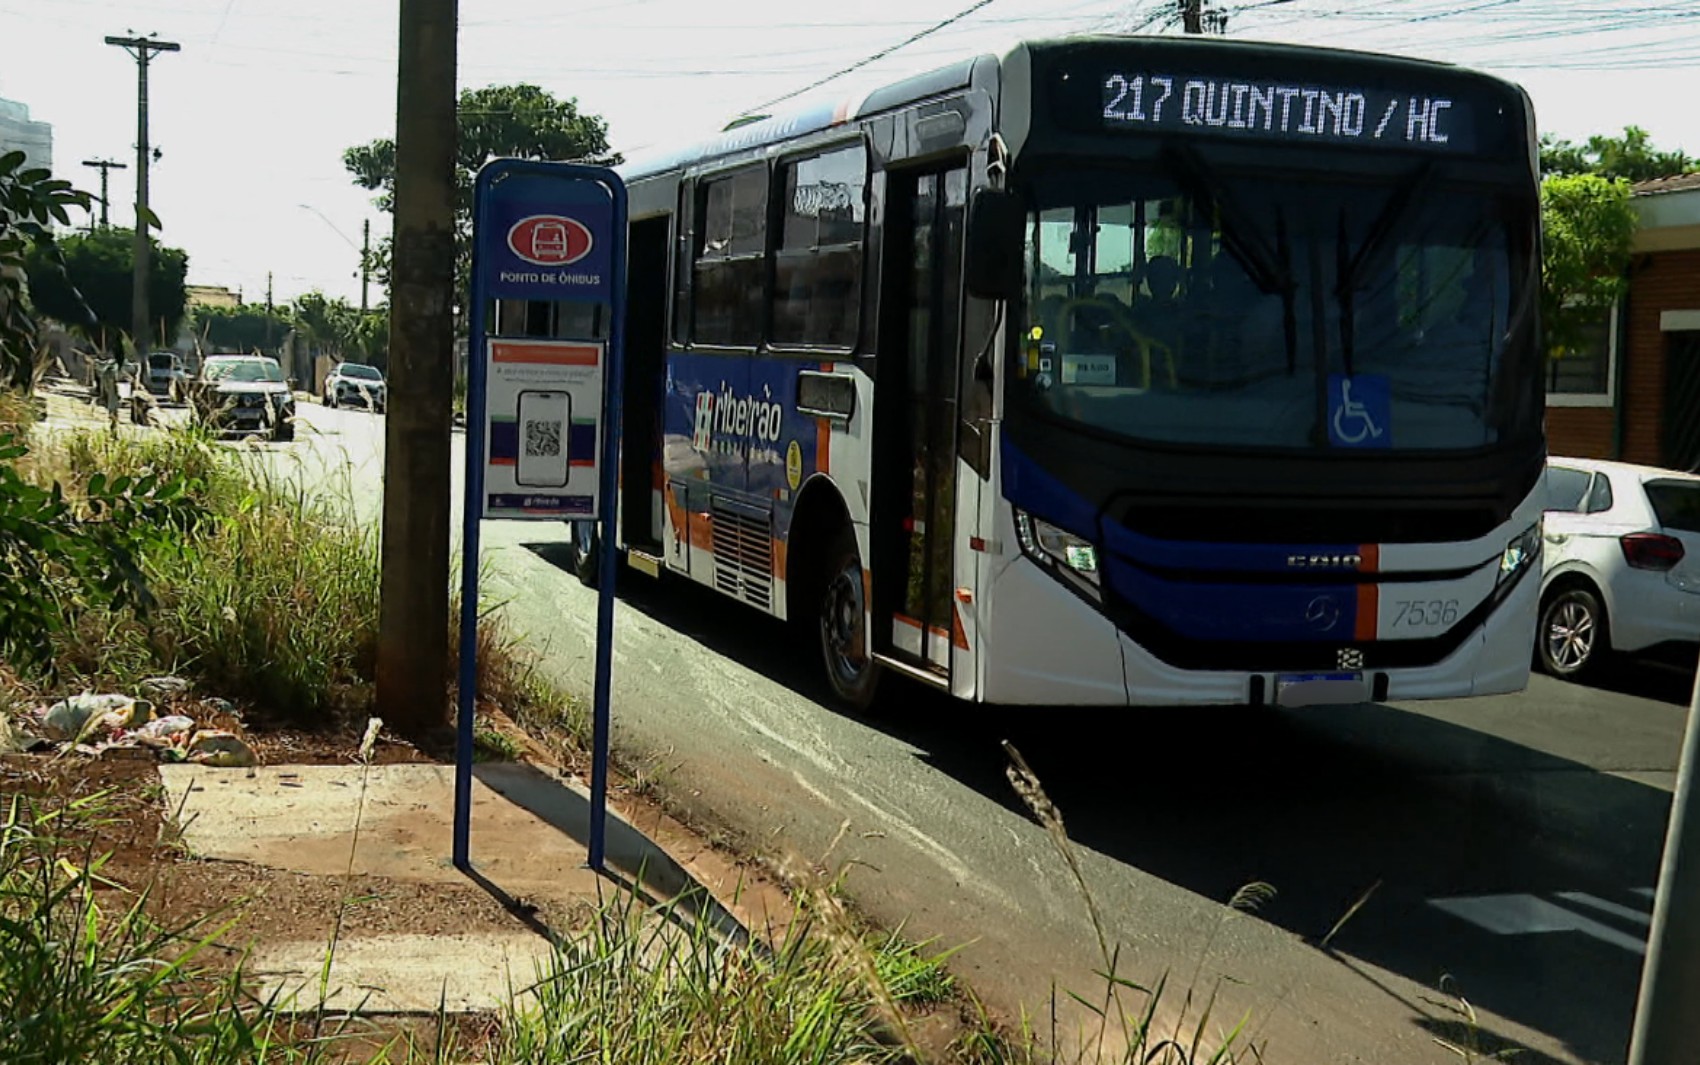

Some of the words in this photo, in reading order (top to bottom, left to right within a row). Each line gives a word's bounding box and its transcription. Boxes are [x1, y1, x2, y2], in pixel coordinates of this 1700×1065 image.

[1103, 74, 1172, 121] 217
[1182, 80, 1365, 136] QUINTINO
[1374, 100, 1398, 138] /
[1406, 98, 1452, 142] HC
[500, 272, 539, 283] PONTO
[541, 273, 557, 284] DE
[558, 270, 600, 285] ÔNIBUS
[714, 380, 782, 442] ribeirão
[1392, 600, 1459, 627] 7536
